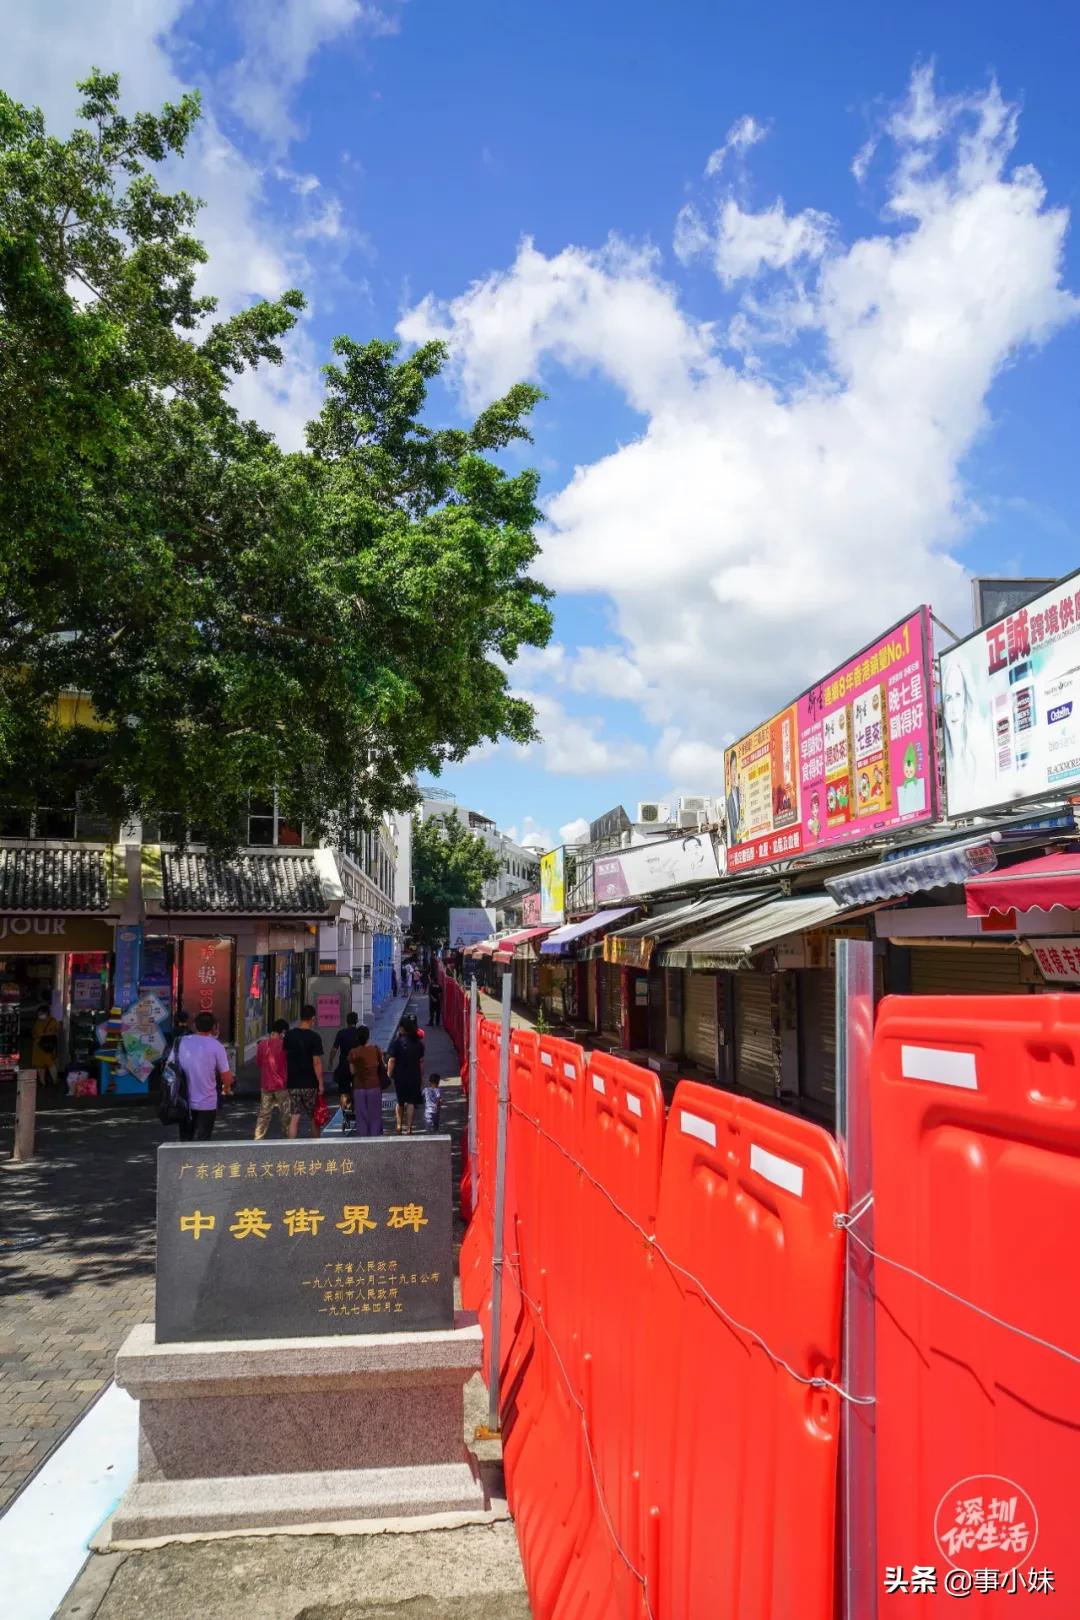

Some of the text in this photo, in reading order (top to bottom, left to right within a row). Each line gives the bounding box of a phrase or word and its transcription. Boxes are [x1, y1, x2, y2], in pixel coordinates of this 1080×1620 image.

[178, 1159, 355, 1181] 广东省重点文物保护单位
[180, 1203, 429, 1240] 中英街界碑
[323, 1260, 398, 1274] 广东省人民政府
[323, 1288, 398, 1302] 深圳市人民政府
[318, 1302, 403, 1316] 一九九七年四月立
